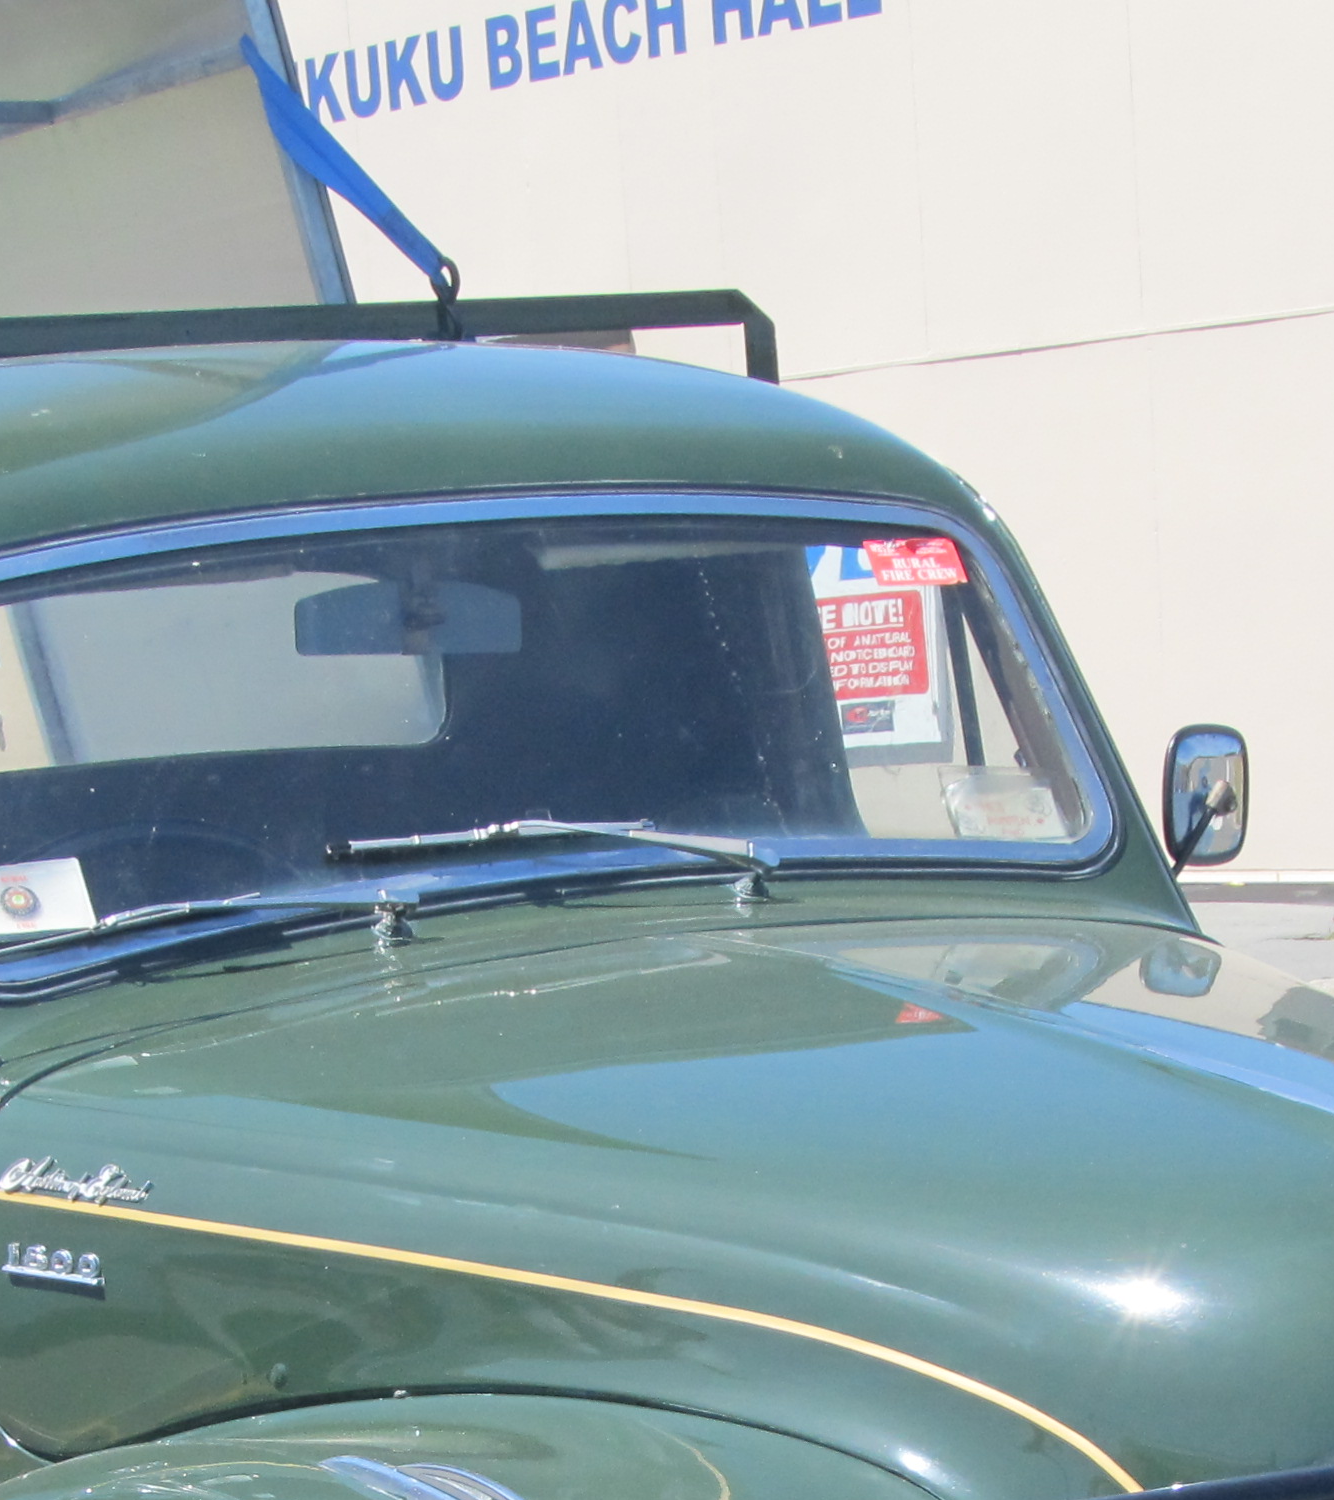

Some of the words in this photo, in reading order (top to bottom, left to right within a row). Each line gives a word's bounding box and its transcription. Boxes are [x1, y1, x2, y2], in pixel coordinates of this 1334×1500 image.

[294, 25, 464, 123] KUKU
[485, 0, 687, 91] BEACH
[711, 0, 883, 46] HA
[892, 557, 941, 569] RURAL
[881, 569, 914, 581] FIRE
[917, 567, 957, 581] CREW
